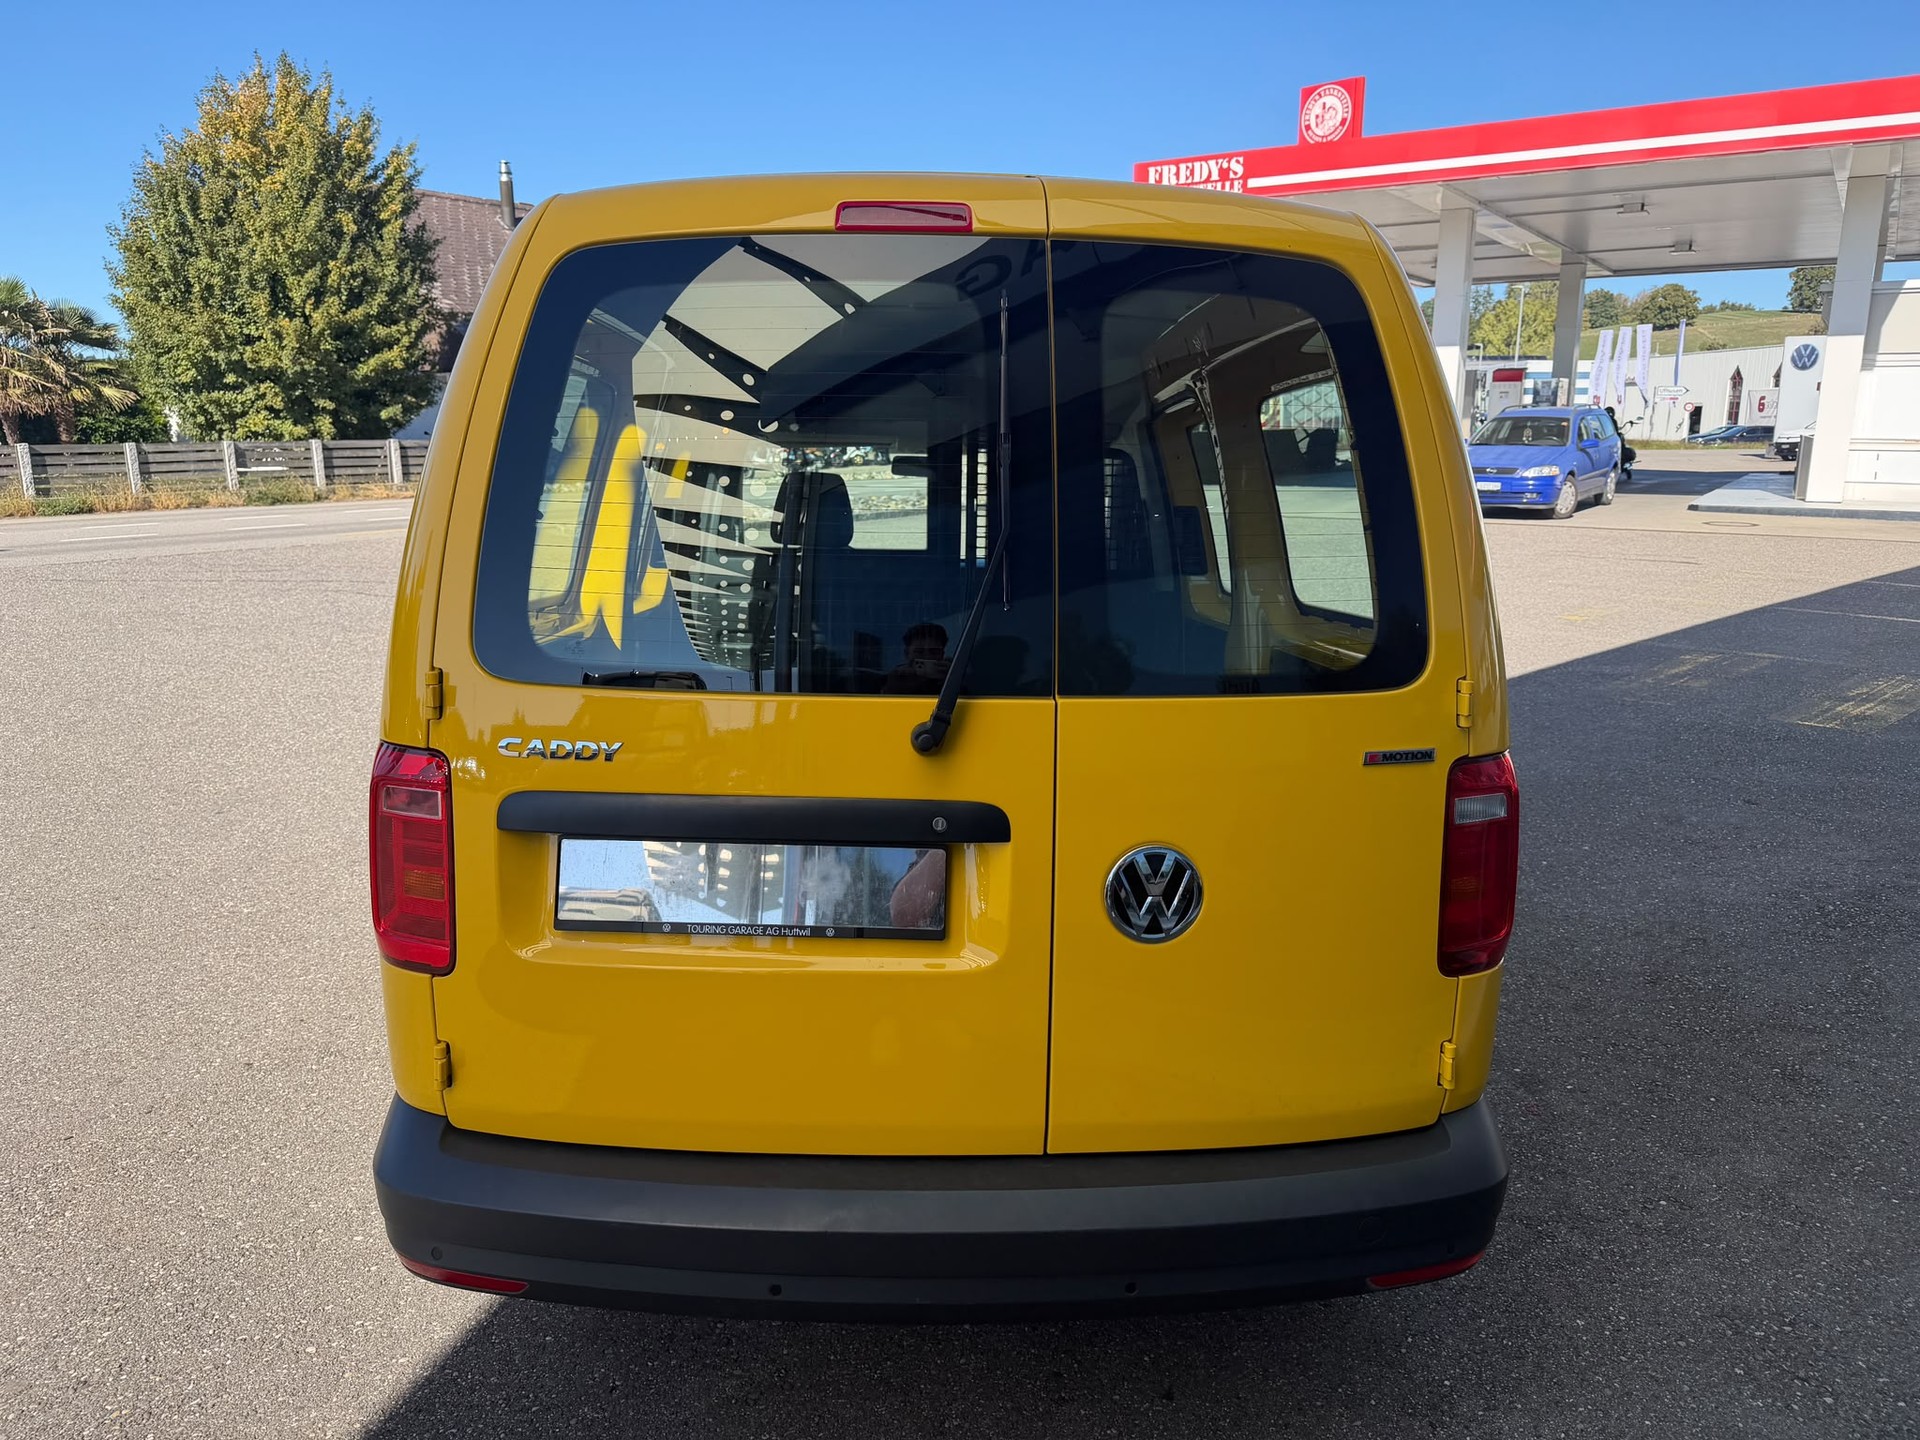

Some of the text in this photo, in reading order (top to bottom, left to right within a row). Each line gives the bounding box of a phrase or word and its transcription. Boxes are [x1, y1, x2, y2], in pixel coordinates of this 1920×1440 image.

[498, 737, 624, 762] CADDY
[686, 924, 726, 934] TOURING
[727, 925, 764, 935] GARAGE
[765, 926, 780, 936] AG
[781, 927, 811, 937] Huttwil
